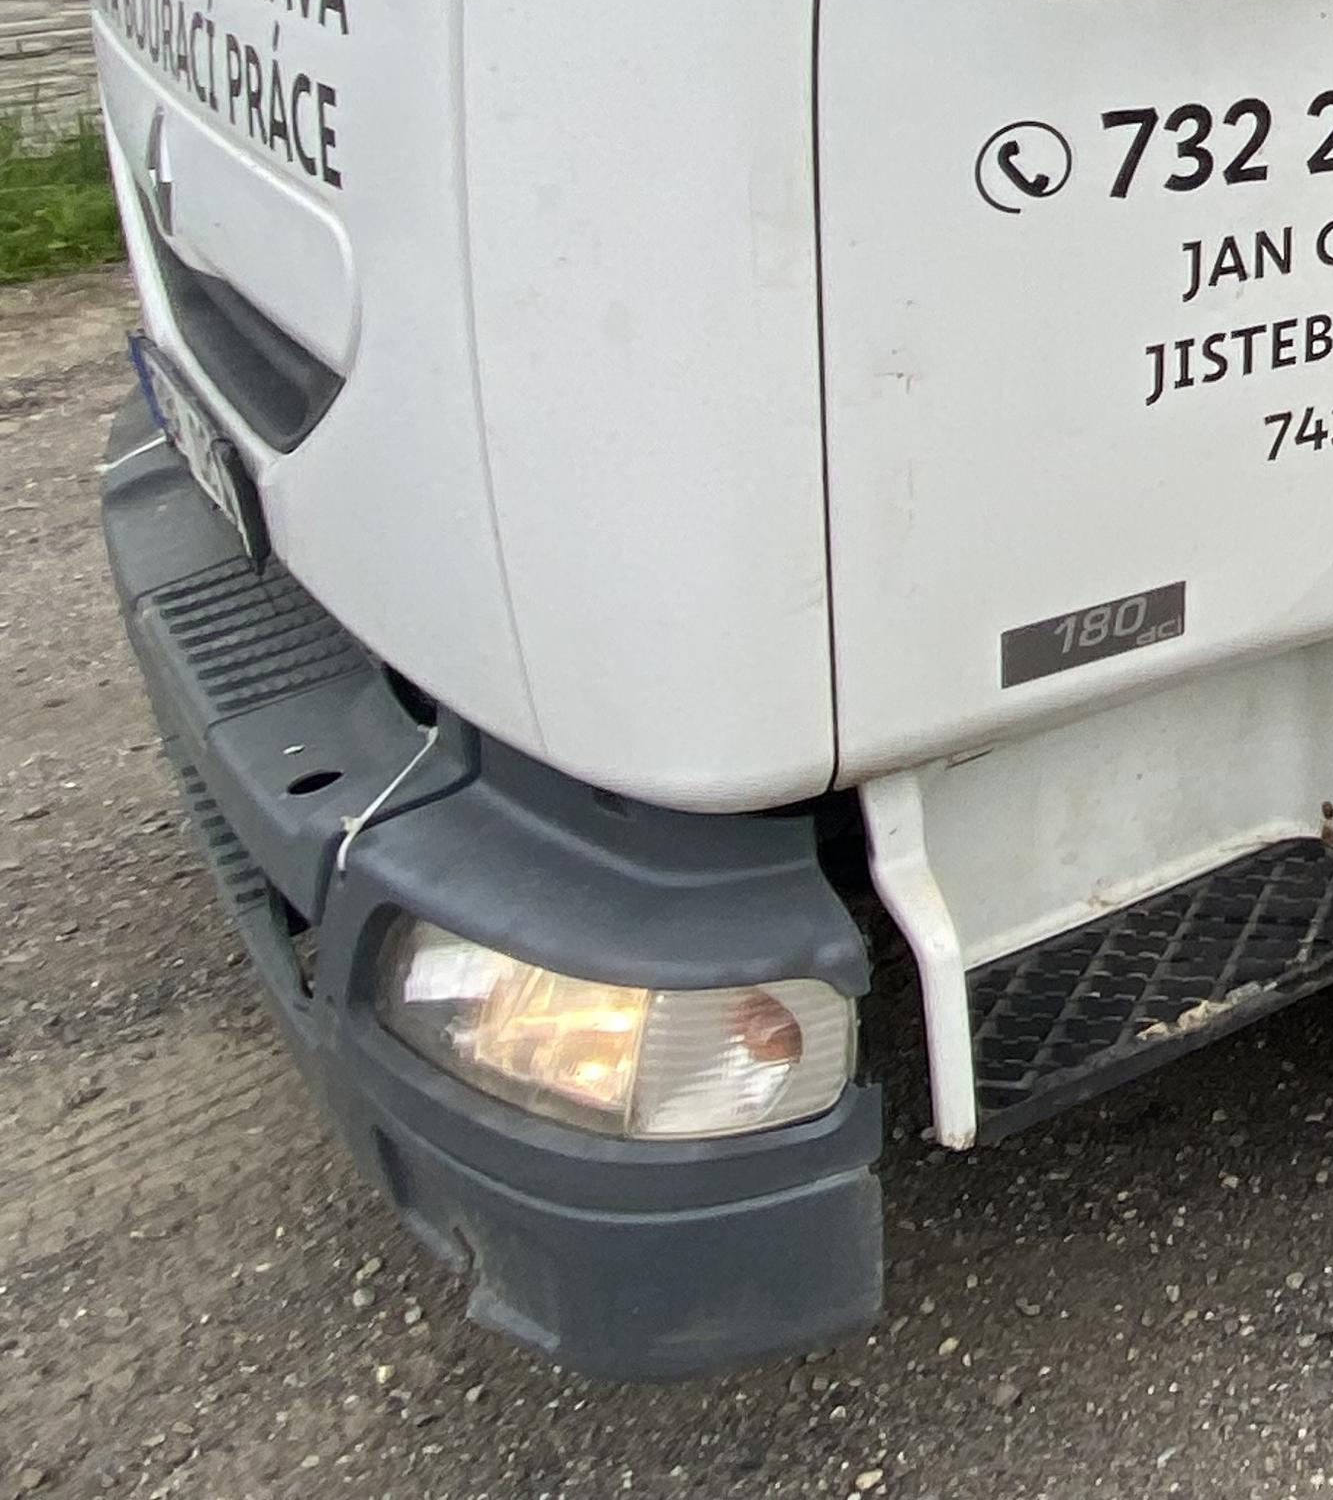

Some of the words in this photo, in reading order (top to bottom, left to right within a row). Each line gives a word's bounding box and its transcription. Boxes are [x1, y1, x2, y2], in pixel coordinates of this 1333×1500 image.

[226, 20, 344, 191] PRÁCE
[1100, 96, 1273, 199] 732
[1181, 226, 1294, 303] JAN
[1053, 595, 1148, 655] 180
